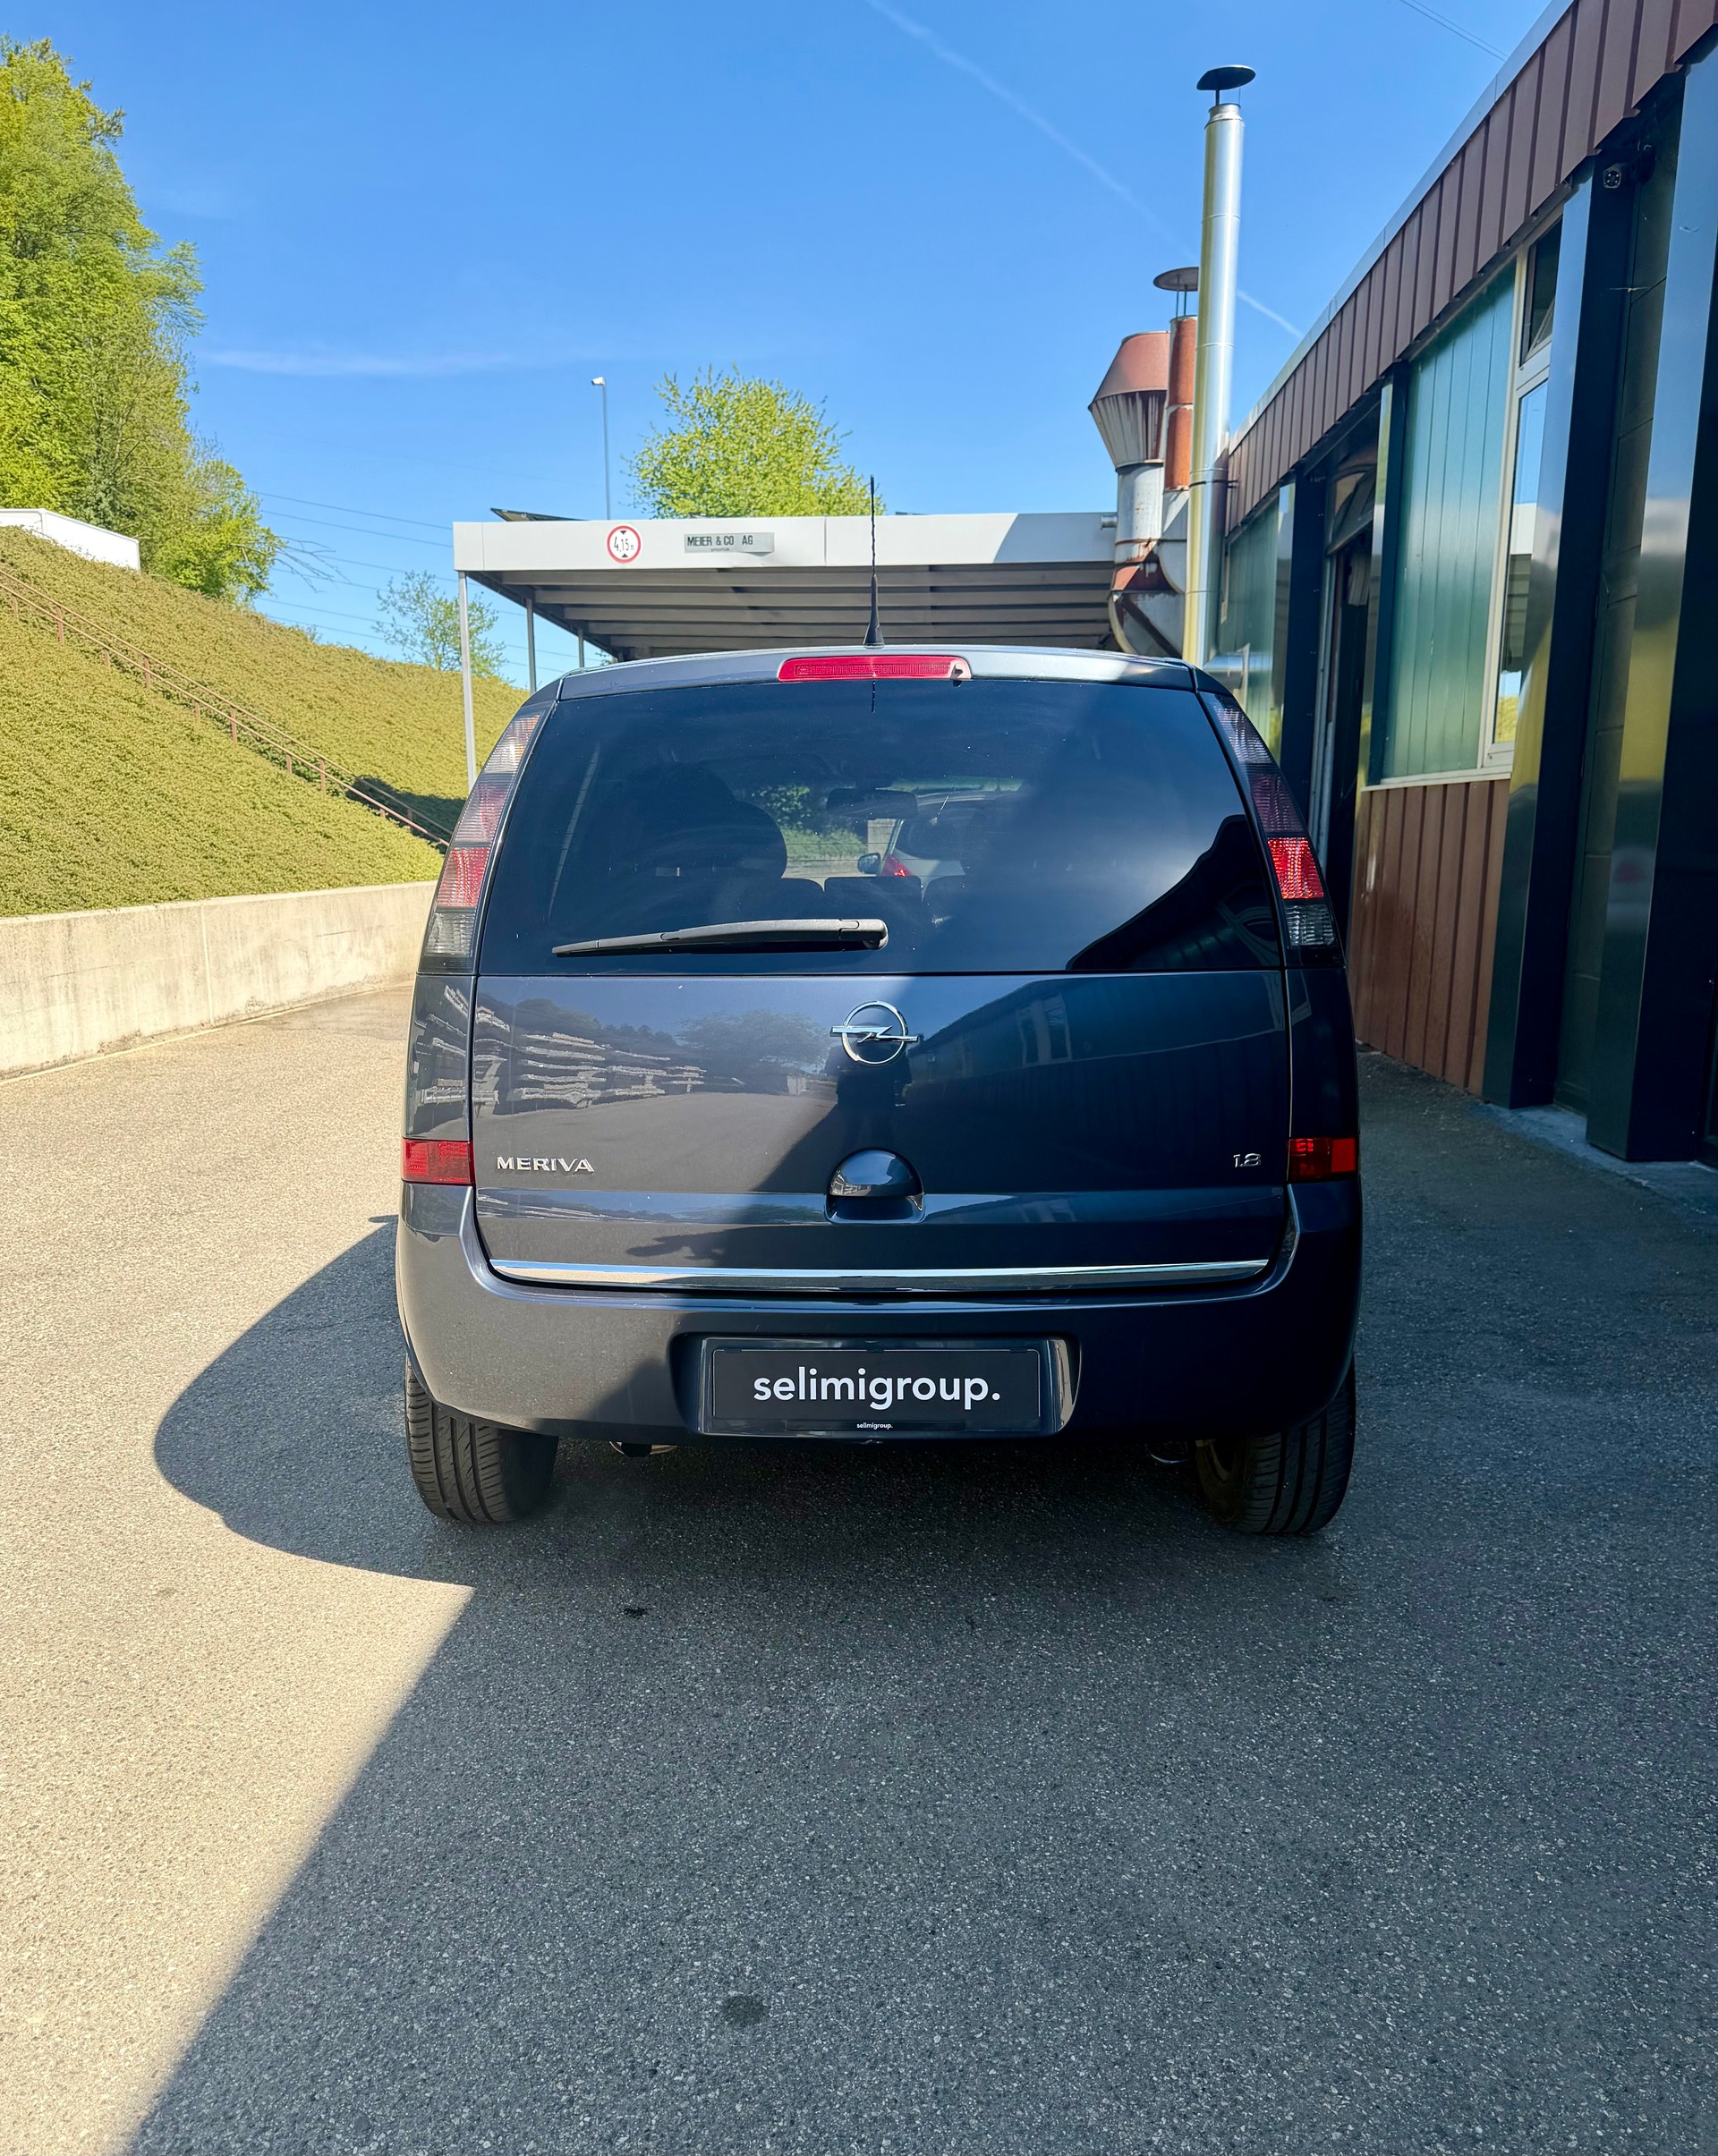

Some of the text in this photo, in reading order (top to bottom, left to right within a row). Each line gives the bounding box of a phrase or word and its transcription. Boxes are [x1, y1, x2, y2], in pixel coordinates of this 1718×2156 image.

[687, 535, 753, 547] MEIER & CO AG
[497, 1156, 595, 1173] MERIVA
[753, 1366, 1001, 1411] selimigroup.
